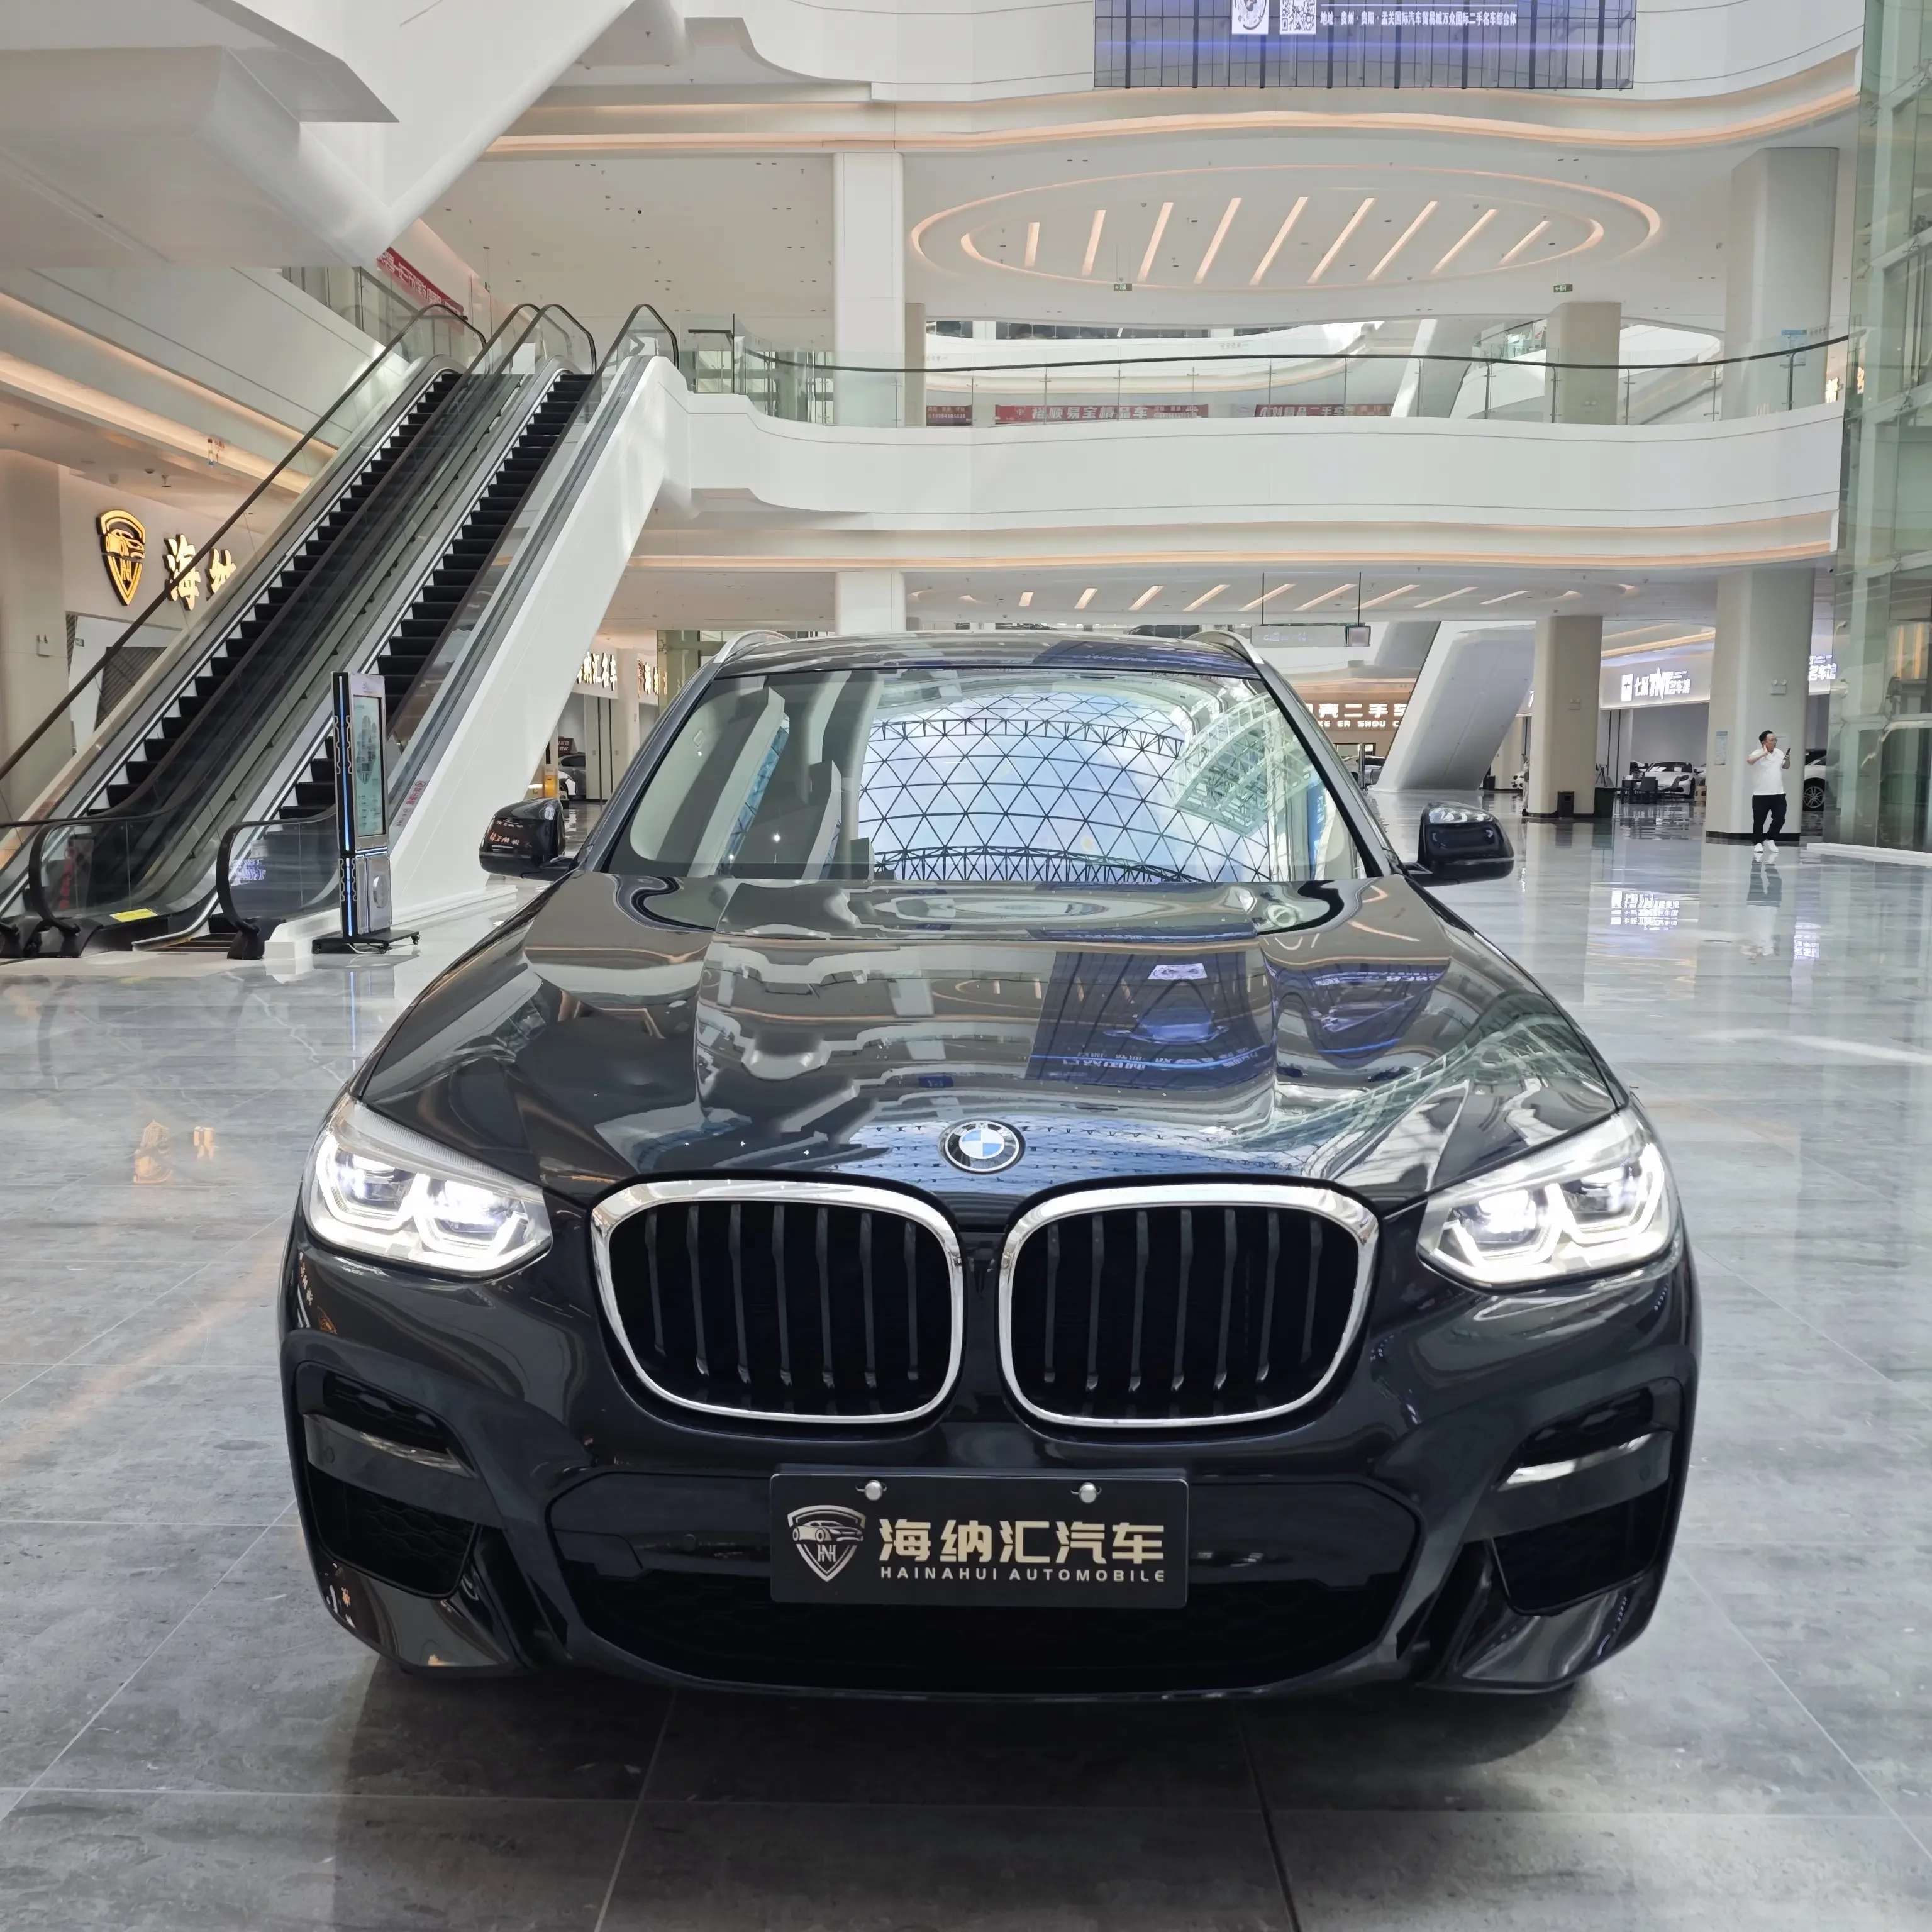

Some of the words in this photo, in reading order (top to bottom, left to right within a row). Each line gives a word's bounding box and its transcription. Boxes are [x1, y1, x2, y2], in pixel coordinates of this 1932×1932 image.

[879, 1518, 1165, 1564] 海纳汇汽车
[881, 1566, 997, 1580] HAINAHUI
[1009, 1568, 1165, 1582] AUTOMOBILE
